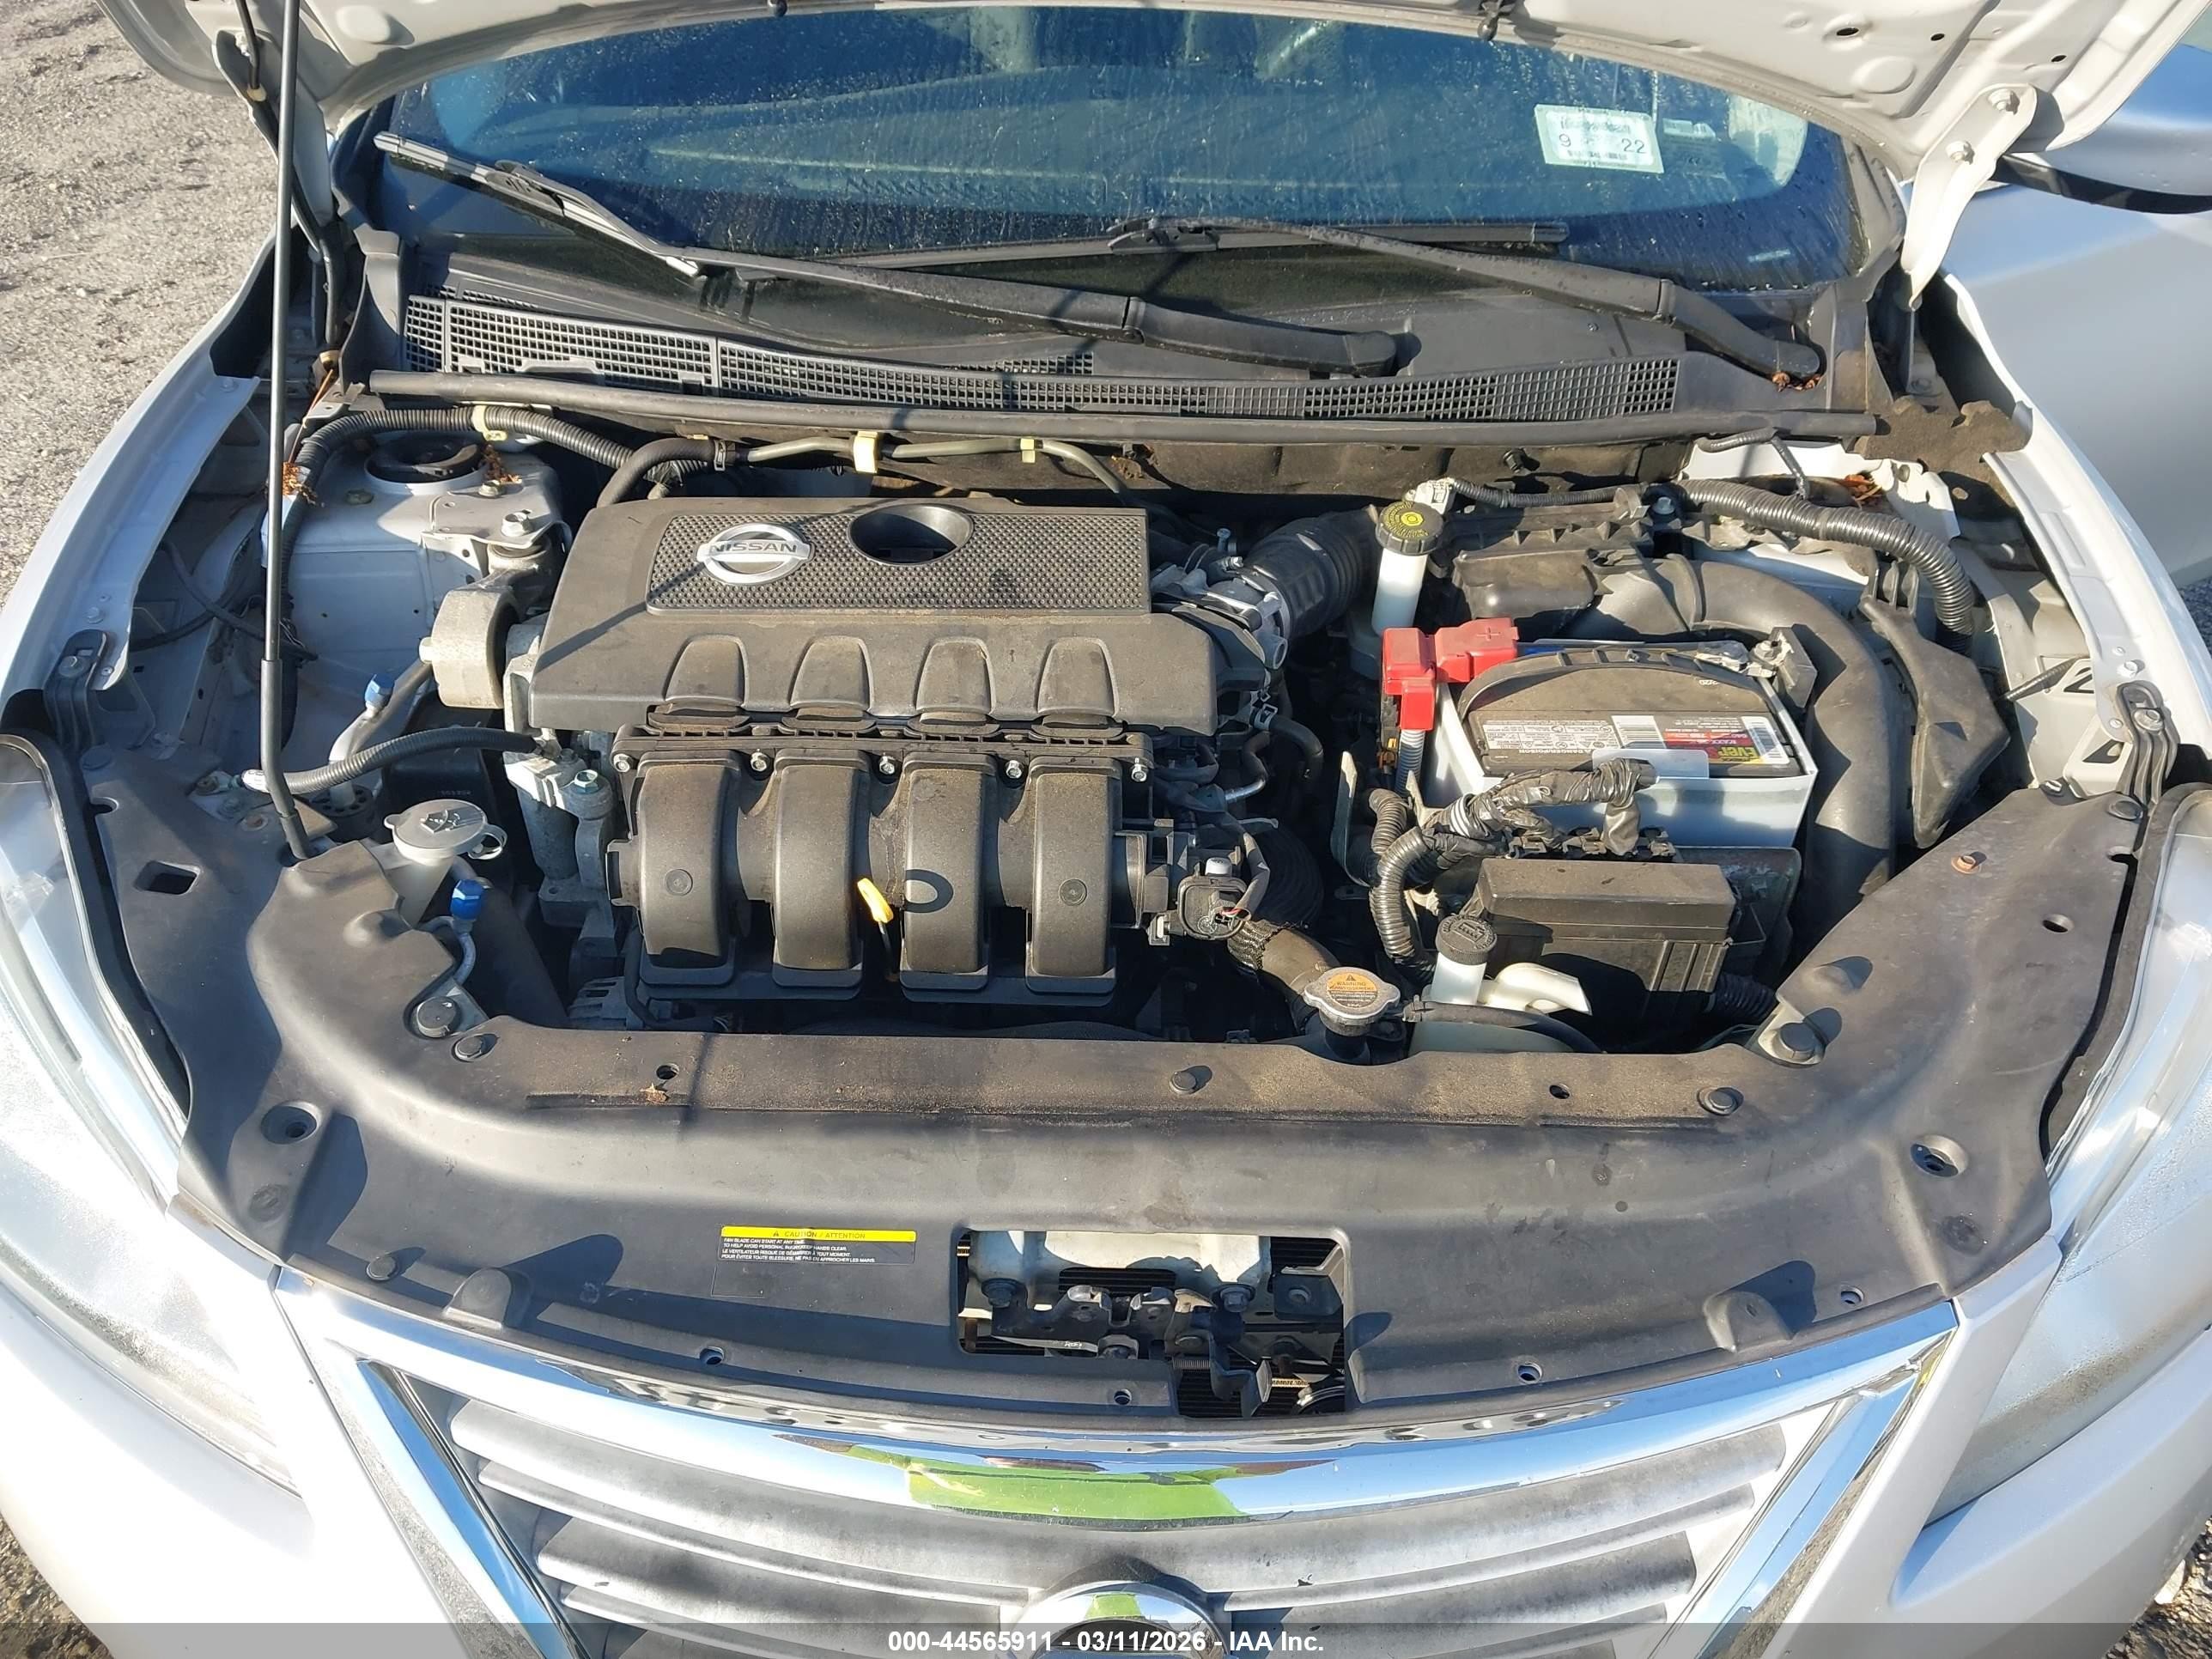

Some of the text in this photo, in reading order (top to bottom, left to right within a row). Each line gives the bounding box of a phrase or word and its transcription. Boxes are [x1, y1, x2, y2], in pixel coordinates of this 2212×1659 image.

[1559, 133, 1647, 154] 9 22
[709, 542, 797, 554] NISSAN
